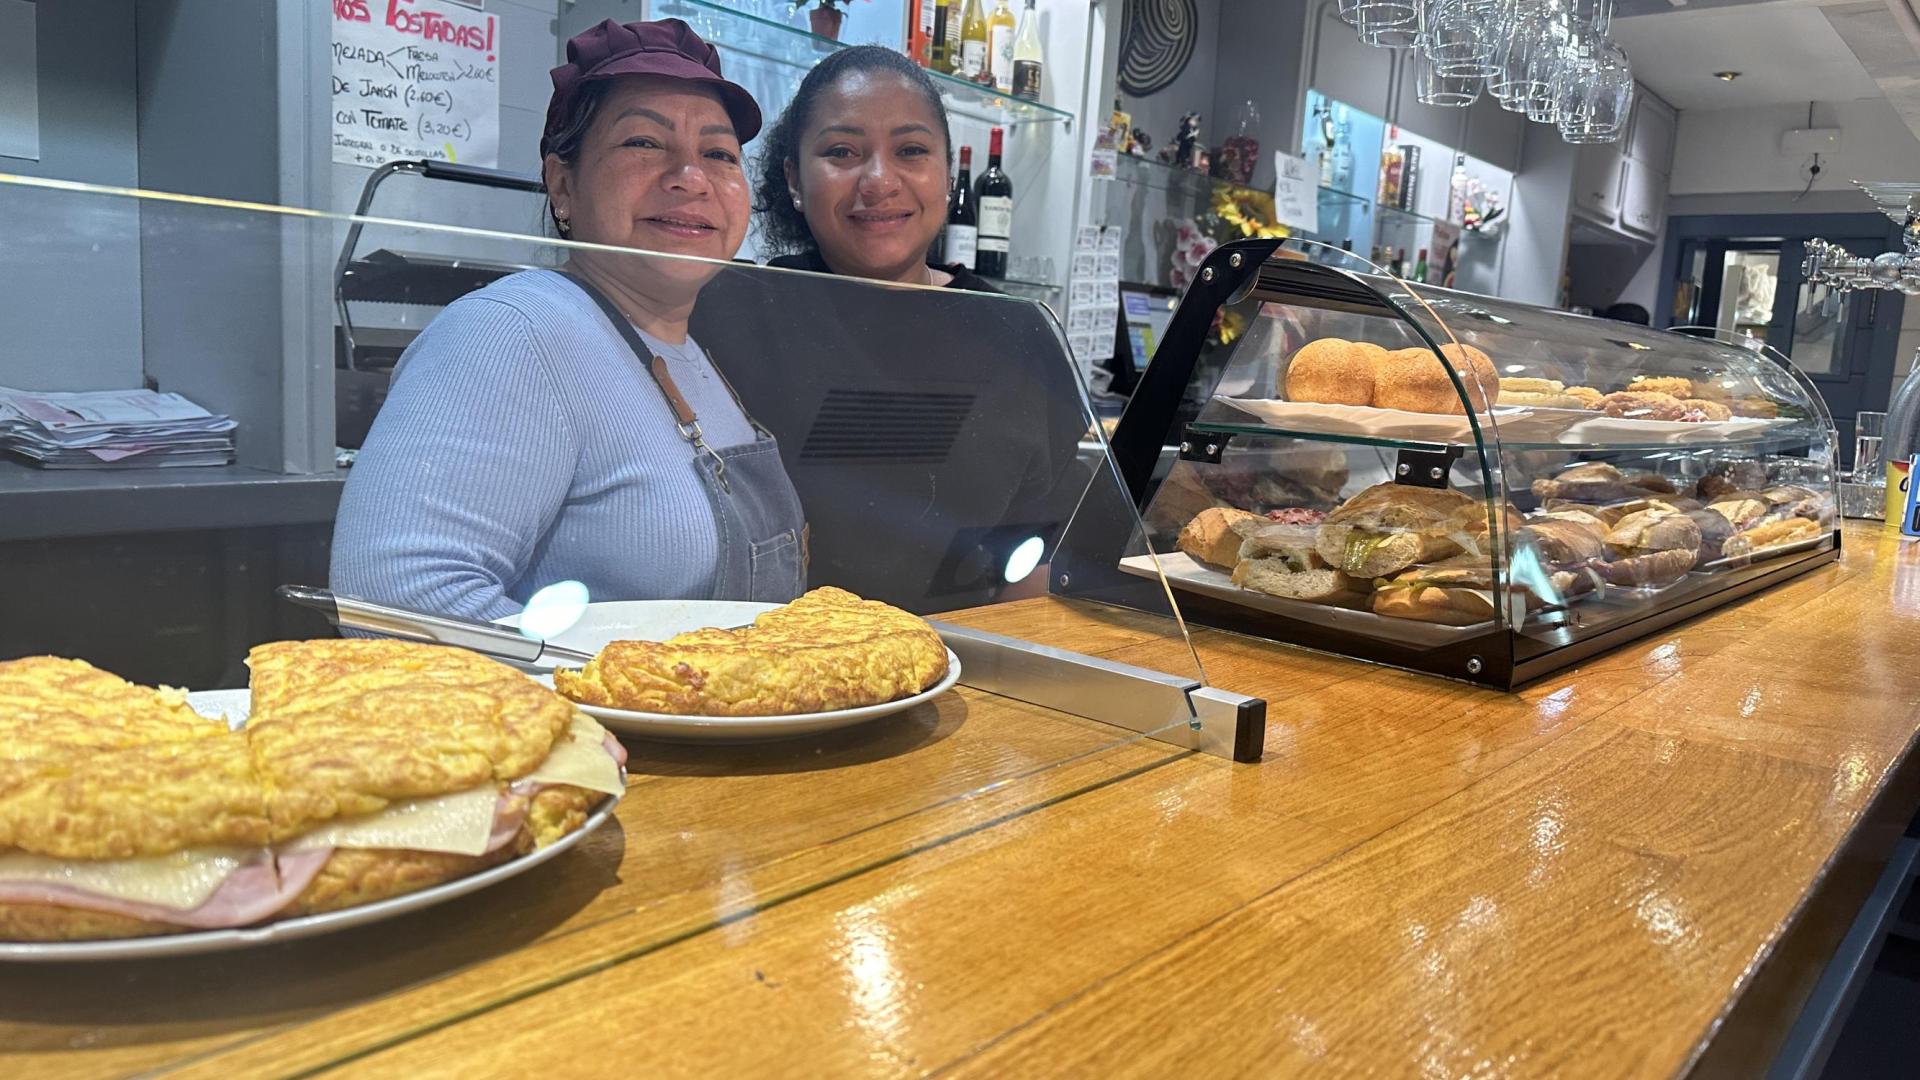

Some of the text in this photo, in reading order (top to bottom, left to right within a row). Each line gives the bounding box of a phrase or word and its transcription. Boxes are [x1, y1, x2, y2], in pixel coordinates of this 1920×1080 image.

[407, 45, 439, 62] FRESA
[332, 75, 350, 95] DE
[359, 79, 398, 99] JAMÓN
[336, 110, 356, 125] CON
[360, 109, 408, 131] TOMATE
